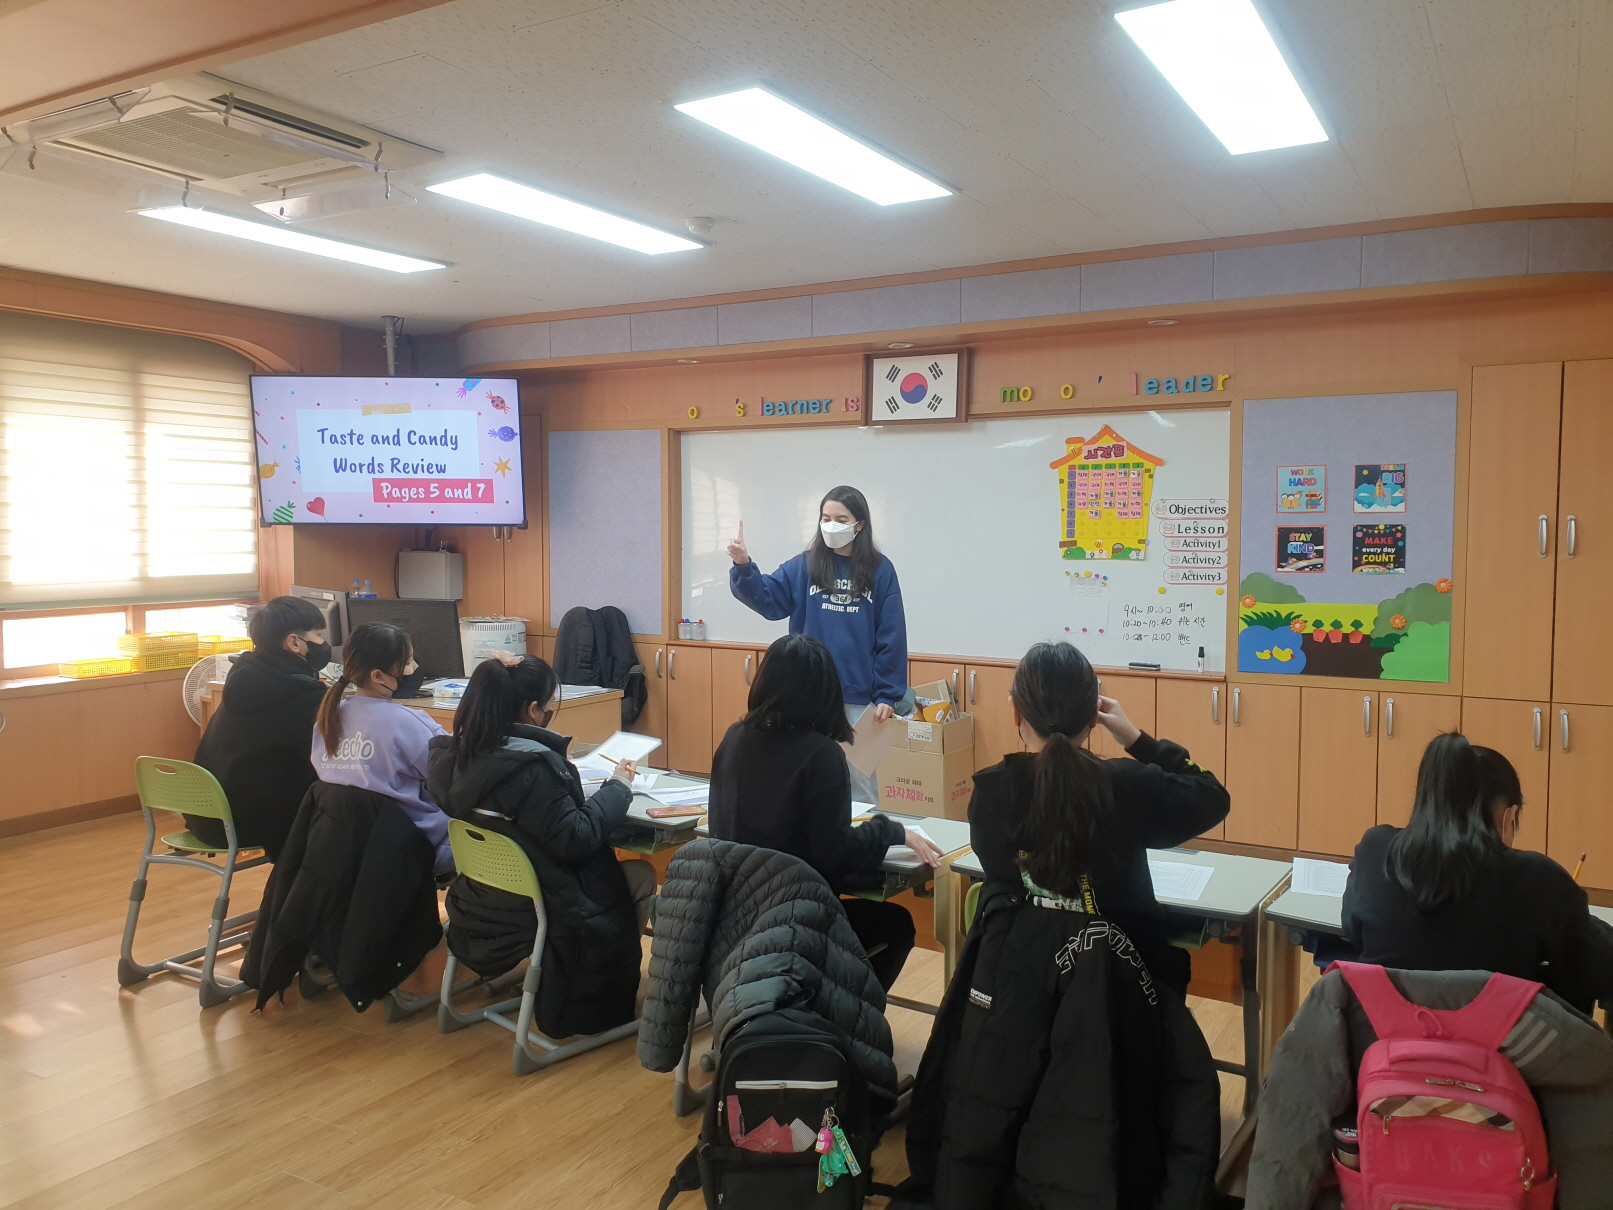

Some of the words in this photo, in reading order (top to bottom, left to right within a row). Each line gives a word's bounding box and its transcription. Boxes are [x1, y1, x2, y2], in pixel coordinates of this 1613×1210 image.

[1131, 372, 1230, 395] leader
[759, 396, 832, 417] learner
[317, 428, 365, 446] Taste
[371, 428, 401, 447] and
[407, 429, 459, 450] Candy
[333, 457, 384, 475] Words
[390, 458, 447, 474] Review
[1290, 468, 1315, 476] WORK
[1288, 477, 1317, 487] HARD
[1382, 472, 1404, 483] BIG
[380, 482, 425, 502] Pages
[429, 483, 440, 498] 5
[444, 482, 472, 499] and
[475, 483, 486, 498] 7
[1169, 504, 1227, 515] Objectives
[1177, 524, 1225, 534] Lesson
[1289, 533, 1312, 542] STAY
[1287, 543, 1315, 553] KIND
[1181, 556, 1221, 565] Activity2
[1362, 554, 1395, 562] COUNT
[1181, 572, 1221, 582] Activity3
[809, 584, 828, 596] OL
[896, 776, 911, 785] 크라운
[1080, 873, 1090, 891] THE
